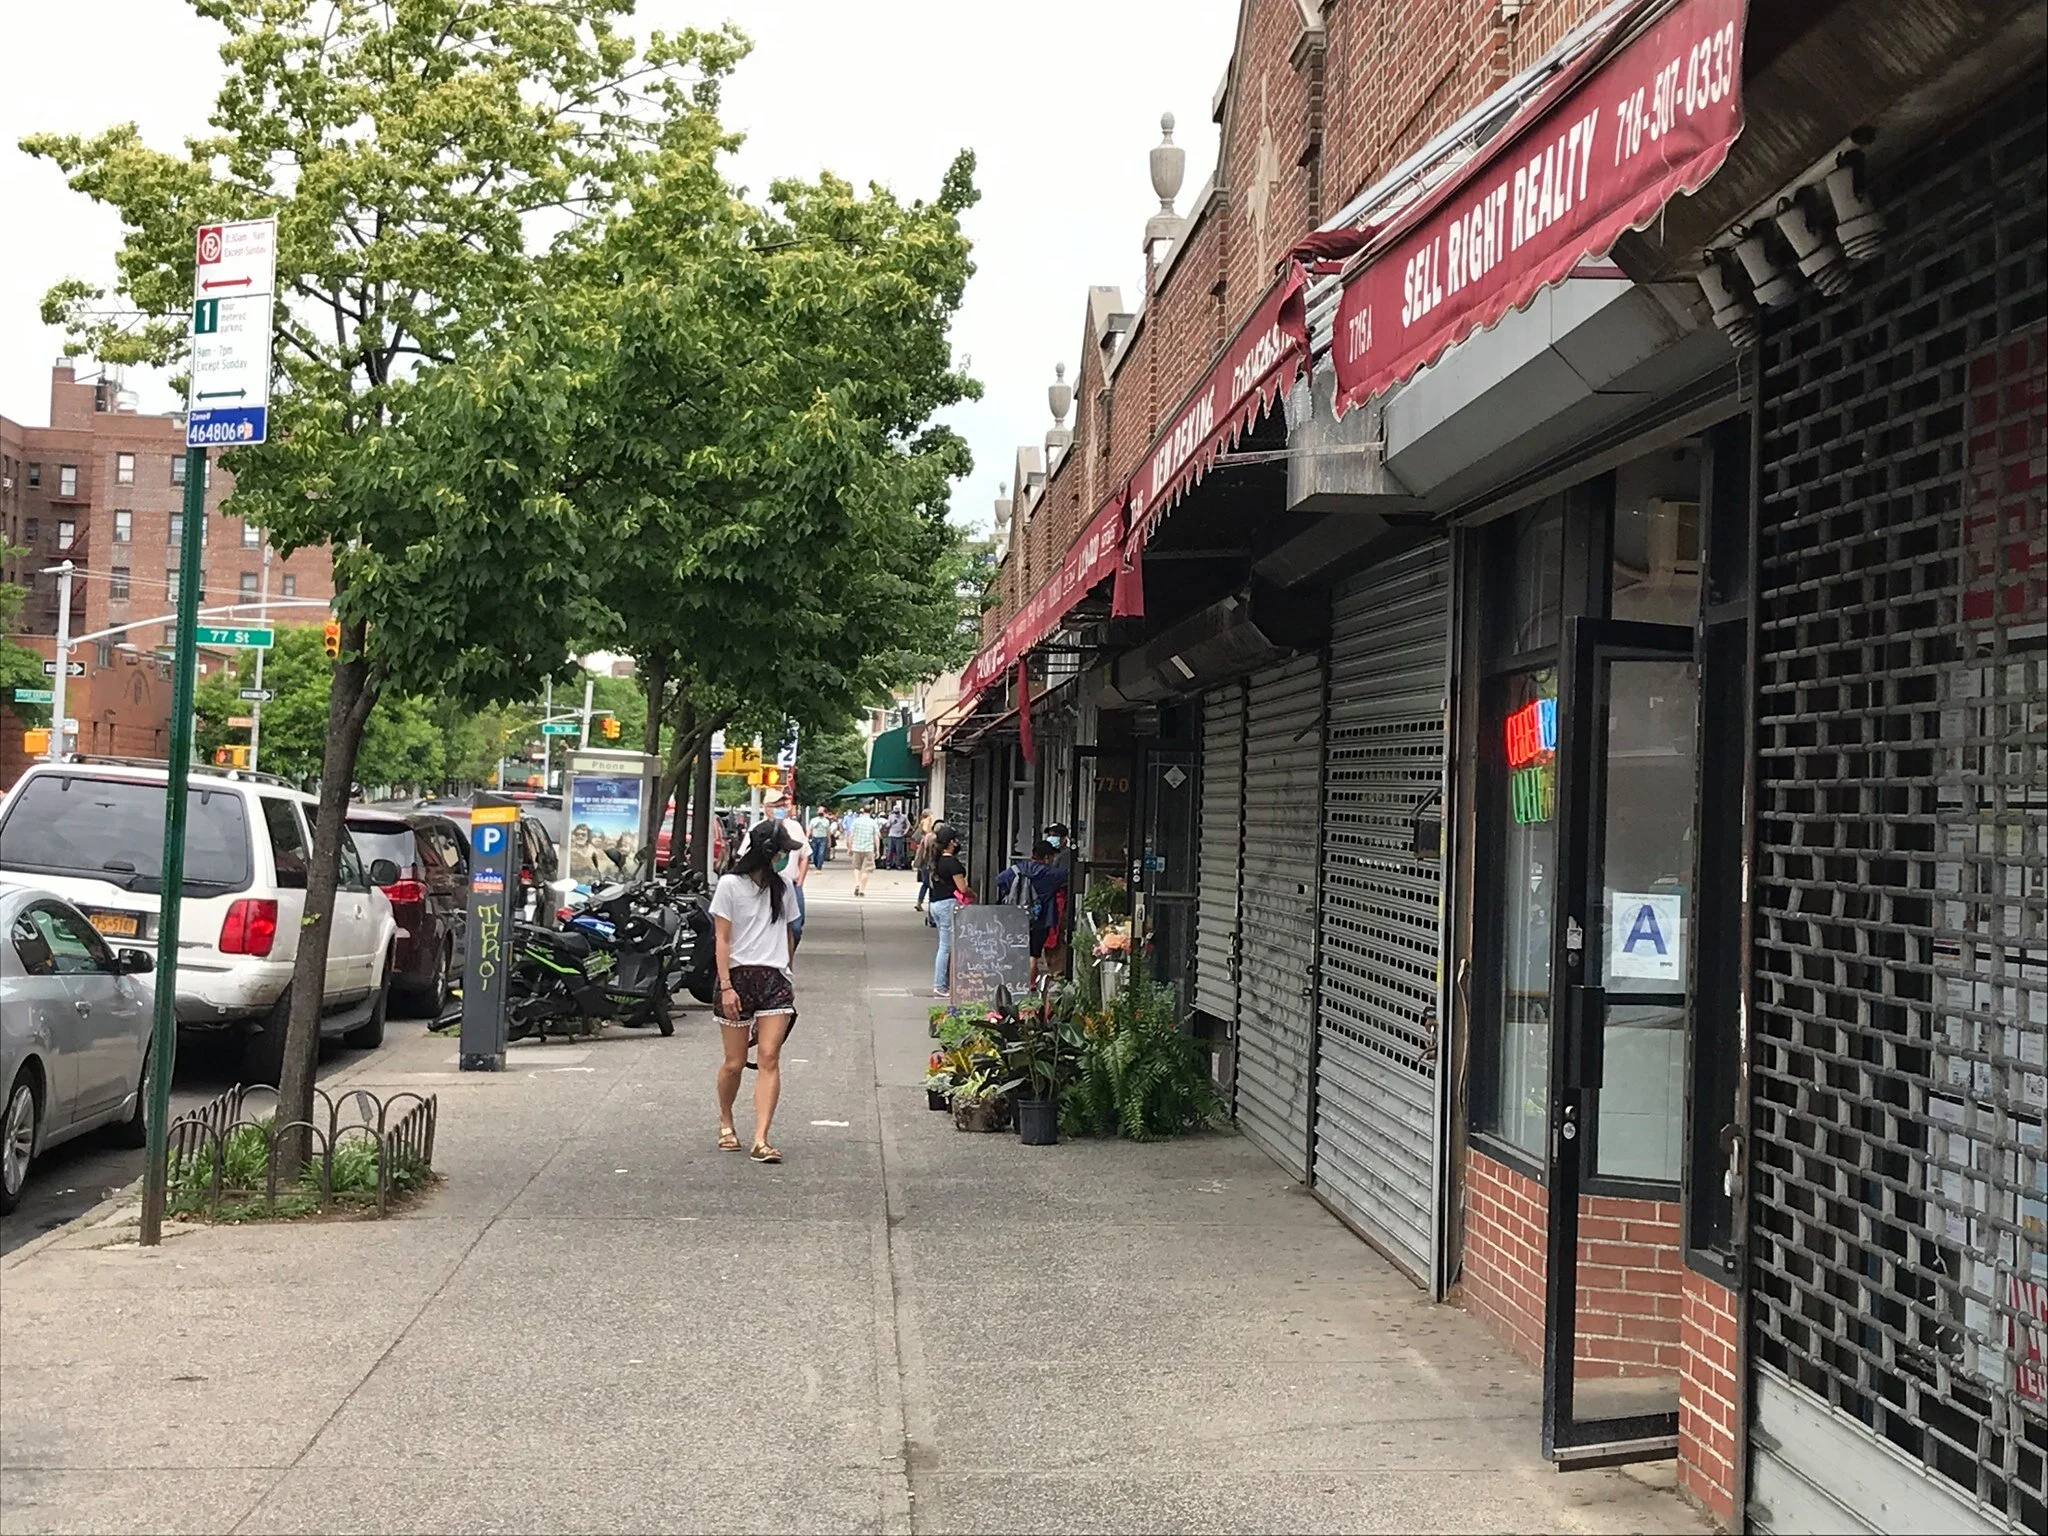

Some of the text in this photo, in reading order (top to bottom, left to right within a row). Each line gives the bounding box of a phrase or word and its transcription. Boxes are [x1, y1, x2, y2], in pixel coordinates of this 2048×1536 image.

[1614, 20, 1734, 167] 718-507-0333
[1402, 107, 1599, 328] SELL RIGHT REALTY
[203, 301, 211, 332] 1
[196, 347, 212, 358] 9am
[218, 345, 233, 356] 7pm
[196, 359, 248, 372] Except Sunday
[190, 422, 236, 442] 464806
[1170, 384, 1215, 478] PEKING
[210, 630, 250, 643] 77 St
[592, 760, 625, 770] Phone
[1622, 904, 1668, 955] A
